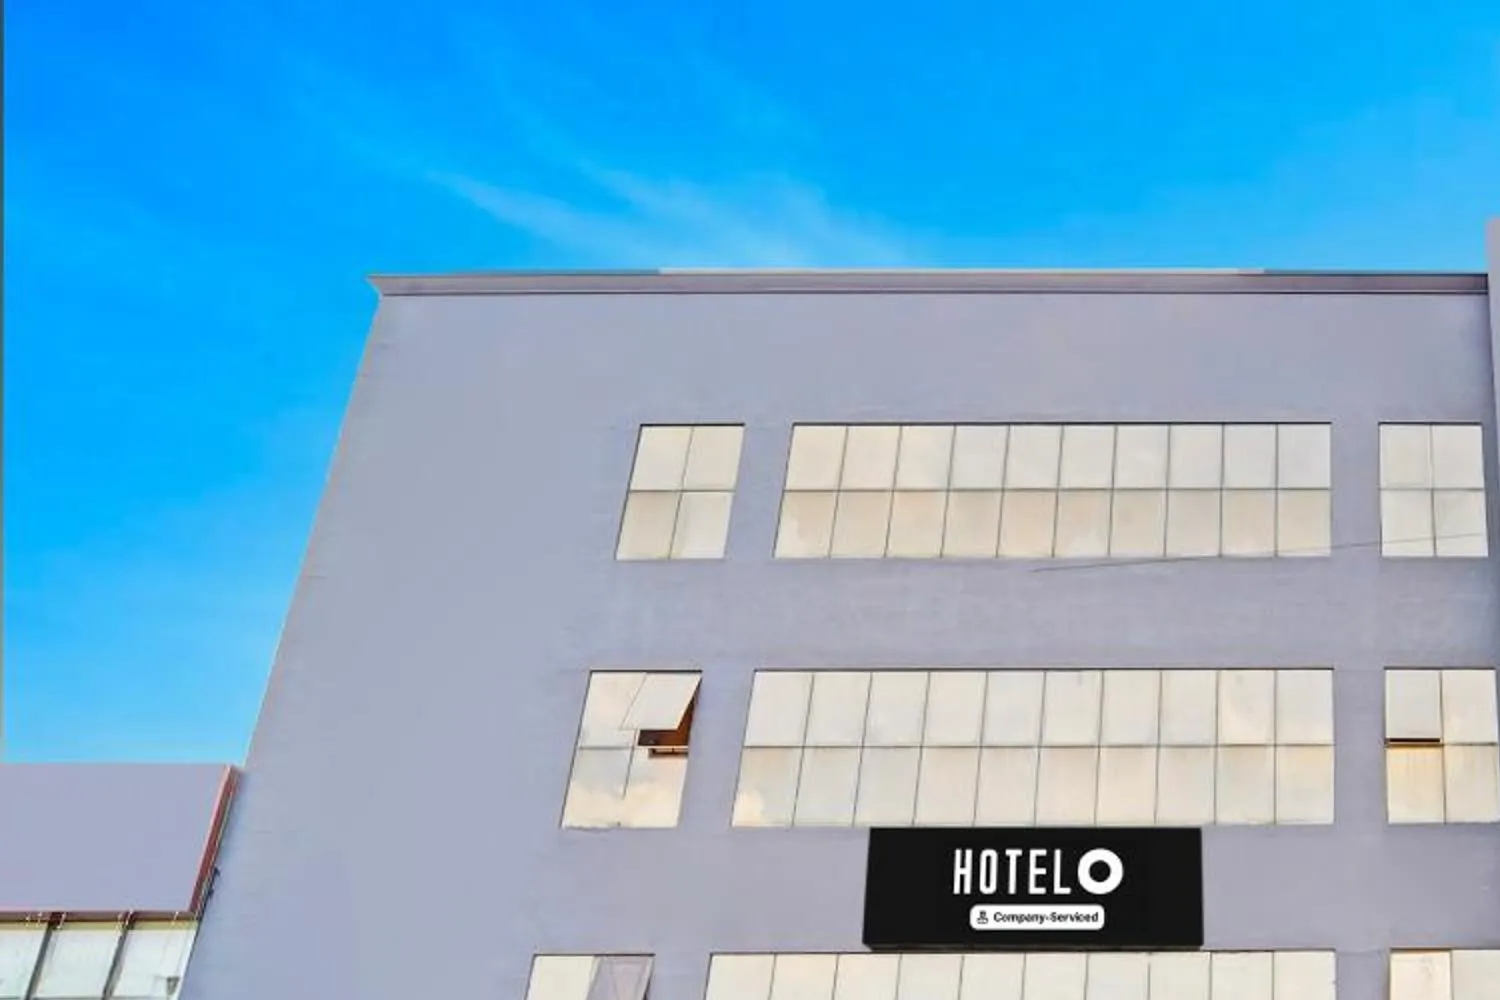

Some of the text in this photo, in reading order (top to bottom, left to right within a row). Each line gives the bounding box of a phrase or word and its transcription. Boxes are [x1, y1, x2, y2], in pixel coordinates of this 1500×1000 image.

[953, 848, 1124, 895] HOTEL O
[993, 911, 1099, 925] Company-Serviced
